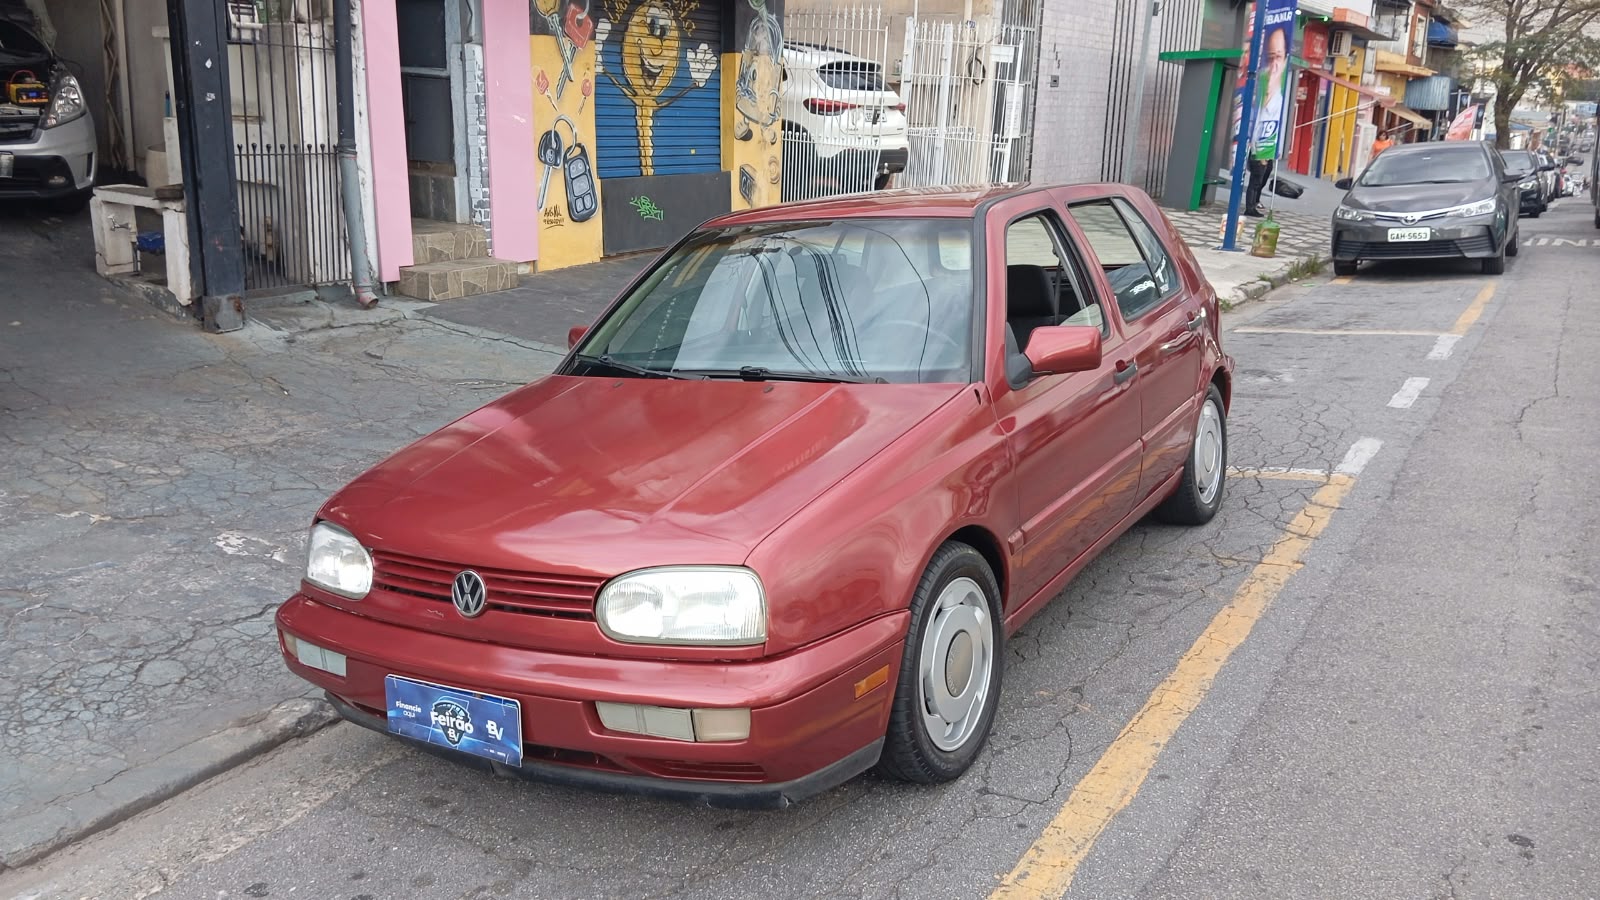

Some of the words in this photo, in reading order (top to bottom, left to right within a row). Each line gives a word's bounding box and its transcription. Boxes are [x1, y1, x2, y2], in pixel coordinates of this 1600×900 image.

[395, 700, 422, 713] Financie
[403, 710, 416, 719] aqui
[430, 711, 474, 734] Feirão
